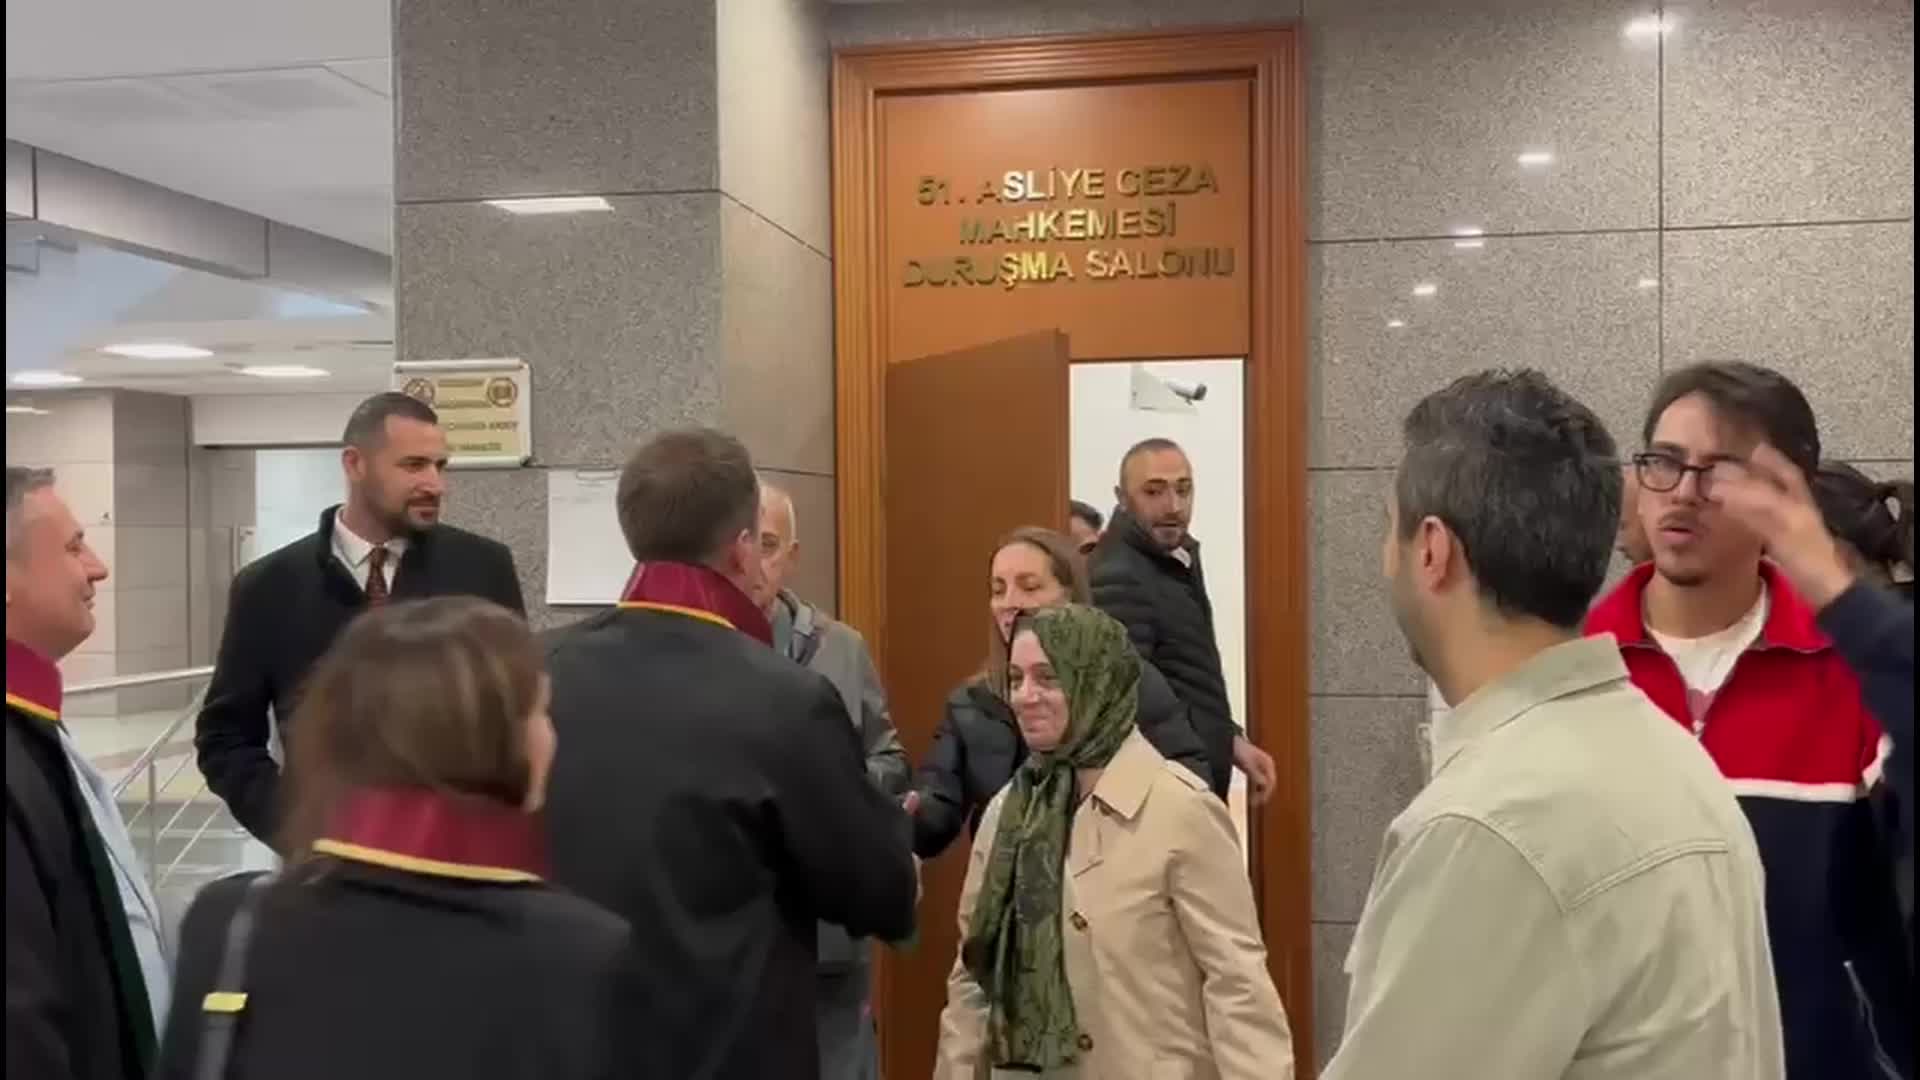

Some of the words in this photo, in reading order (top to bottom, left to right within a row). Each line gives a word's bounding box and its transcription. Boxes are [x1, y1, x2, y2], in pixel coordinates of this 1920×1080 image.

[977, 167, 1106, 203] ASLİYE
[1117, 164, 1219, 198] CEZA
[961, 203, 1176, 246] MAHKEMESİ
[905, 251, 1074, 291] DURUŞMA
[1087, 247, 1235, 280] SALONU
